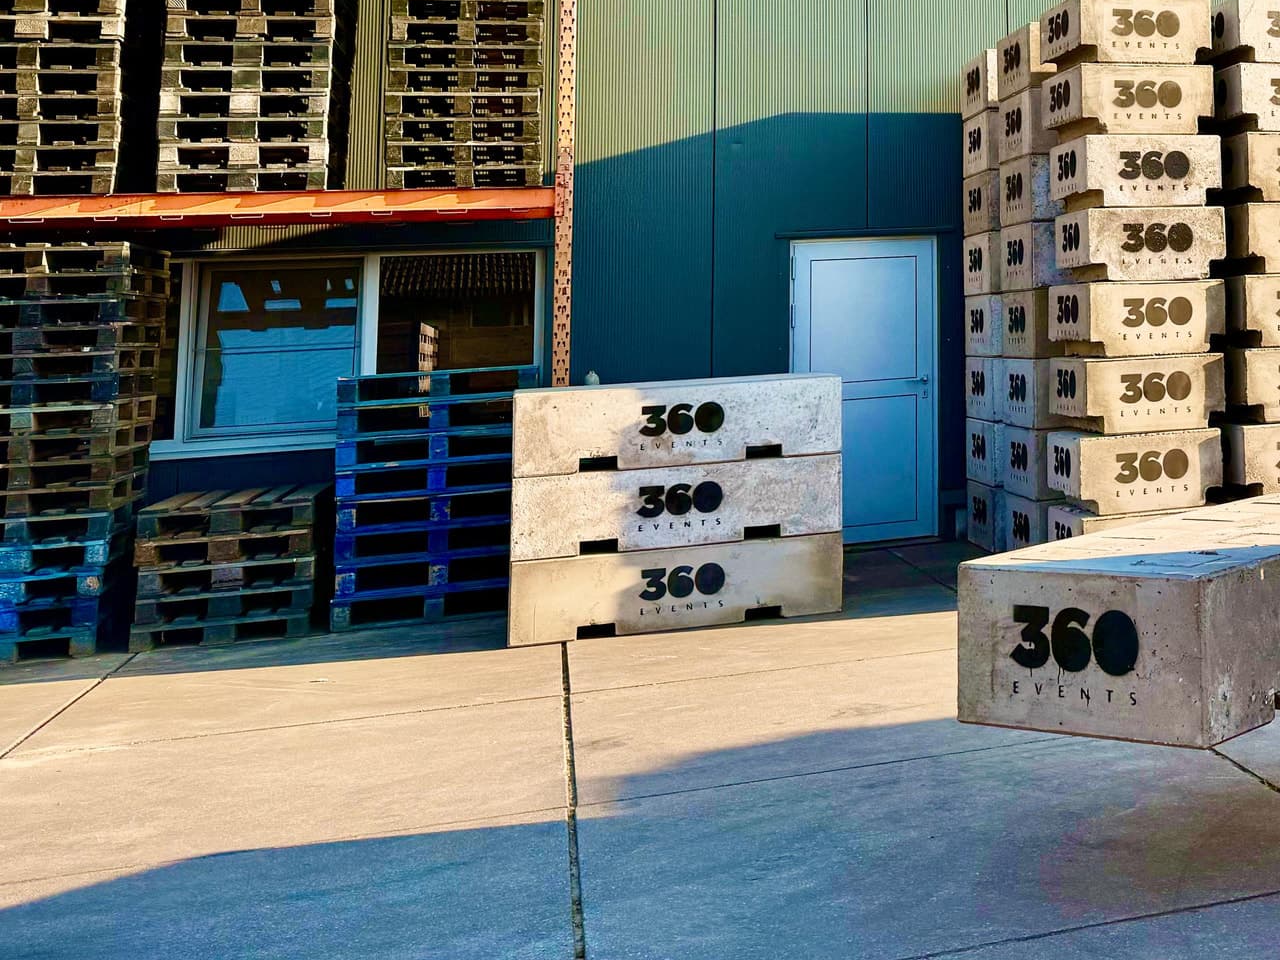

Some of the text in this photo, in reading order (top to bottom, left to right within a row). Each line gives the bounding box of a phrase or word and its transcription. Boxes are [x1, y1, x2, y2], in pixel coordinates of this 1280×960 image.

[1048, 9, 1069, 44] 360
[1112, 9, 1180, 37] 360
[1003, 41, 1021, 74] 360
[1049, 79, 1071, 113] 360
[1112, 80, 1182, 108] 360
[1005, 107, 1022, 137] 360
[1113, 112, 1182, 120] EVENTS
[1057, 149, 1077, 181] 360
[1118, 151, 1190, 180] 360
[1006, 172, 1023, 202] 360
[1006, 238, 1024, 266] 360
[1062, 222, 1080, 252] 360
[1121, 222, 1193, 253] 360
[1008, 306, 1026, 334] 360
[1057, 294, 1079, 324] 360
[1121, 296, 1193, 328] 360
[1123, 331, 1192, 341] EVENTS
[1009, 374, 1027, 402] 360
[1057, 369, 1077, 399] 360
[1120, 371, 1192, 404] 360
[639, 401, 725, 437] 360
[1120, 406, 1191, 417] EVENTS
[640, 439, 723, 451] EVENTS
[1010, 441, 1028, 472] 360
[1053, 445, 1071, 479] 360
[1114, 448, 1189, 484] 360
[636, 481, 723, 518] 360
[1116, 484, 1189, 497] EVENTS
[638, 517, 721, 532] EVENTS
[639, 562, 725, 601] 360
[639, 599, 724, 616] EVENTS
[1009, 605, 1140, 676] 360
[1012, 680, 1137, 707] EVENTS
